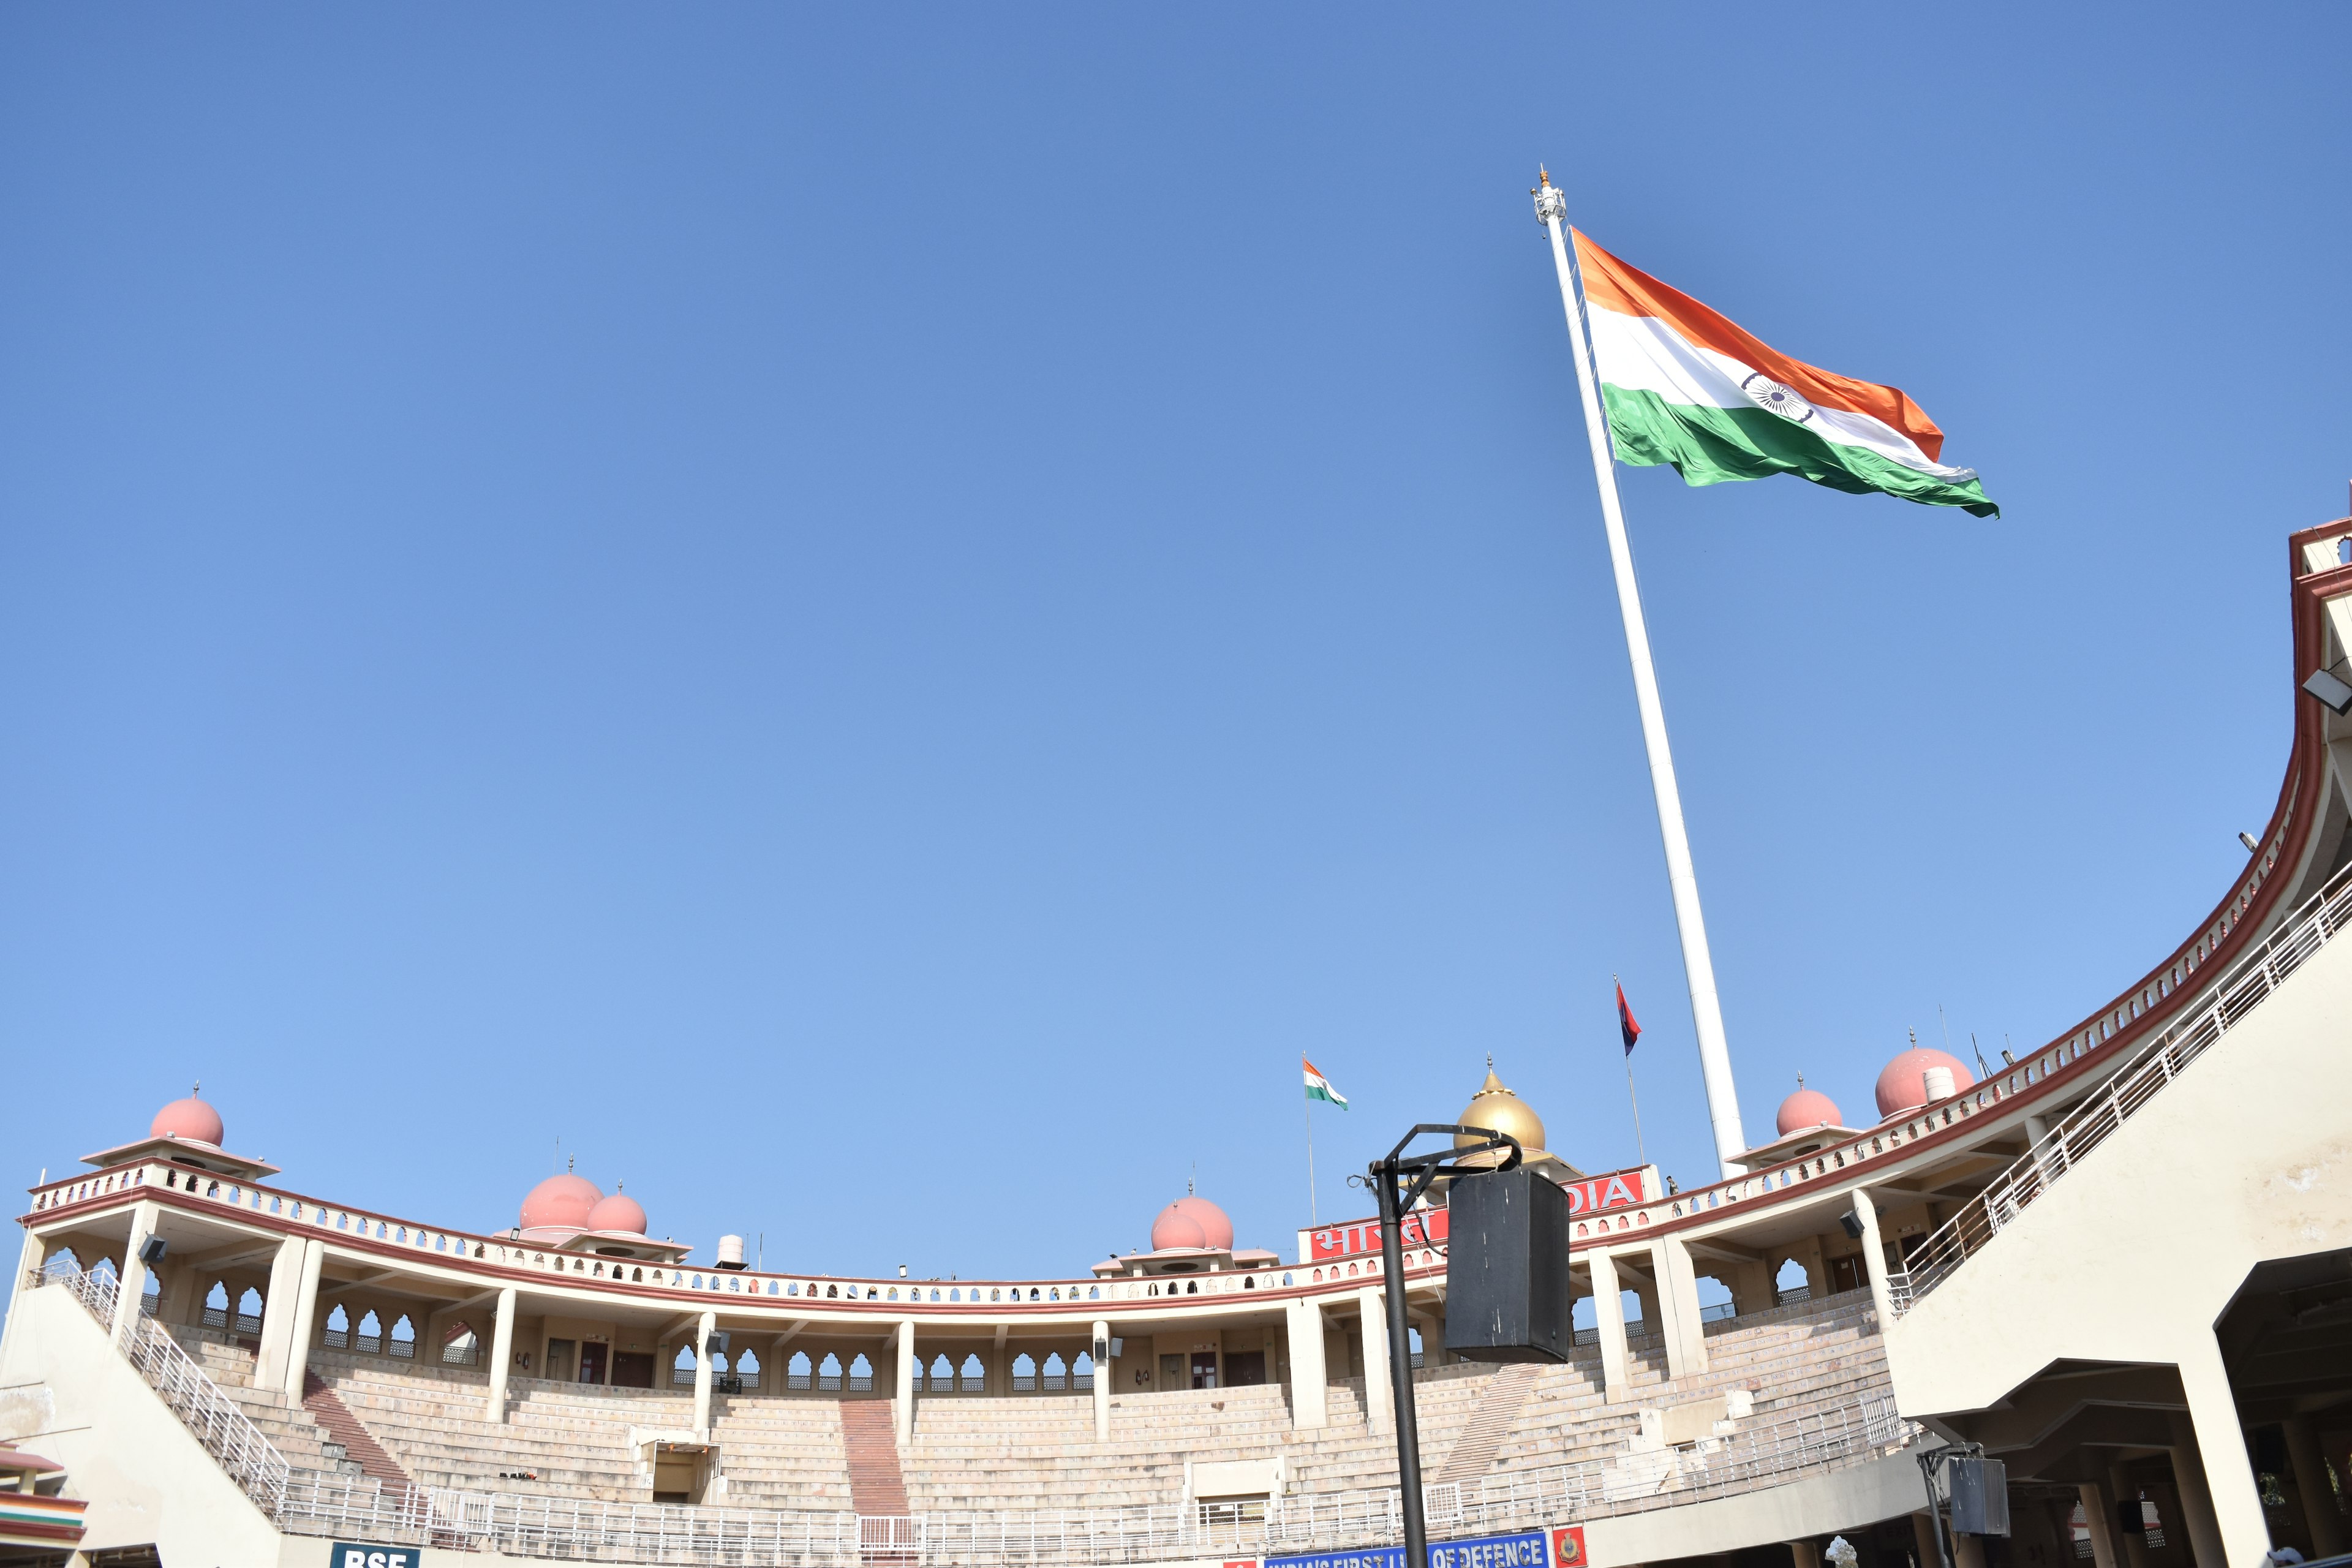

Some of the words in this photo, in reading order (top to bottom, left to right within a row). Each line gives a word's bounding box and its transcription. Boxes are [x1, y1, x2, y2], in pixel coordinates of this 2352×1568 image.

[1564, 1177, 1637, 1215] DIA
[1316, 1212, 1435, 1254] भात
[1433, 1548, 1455, 1568] OF
[1459, 1540, 1543, 1568] DEFENCE
